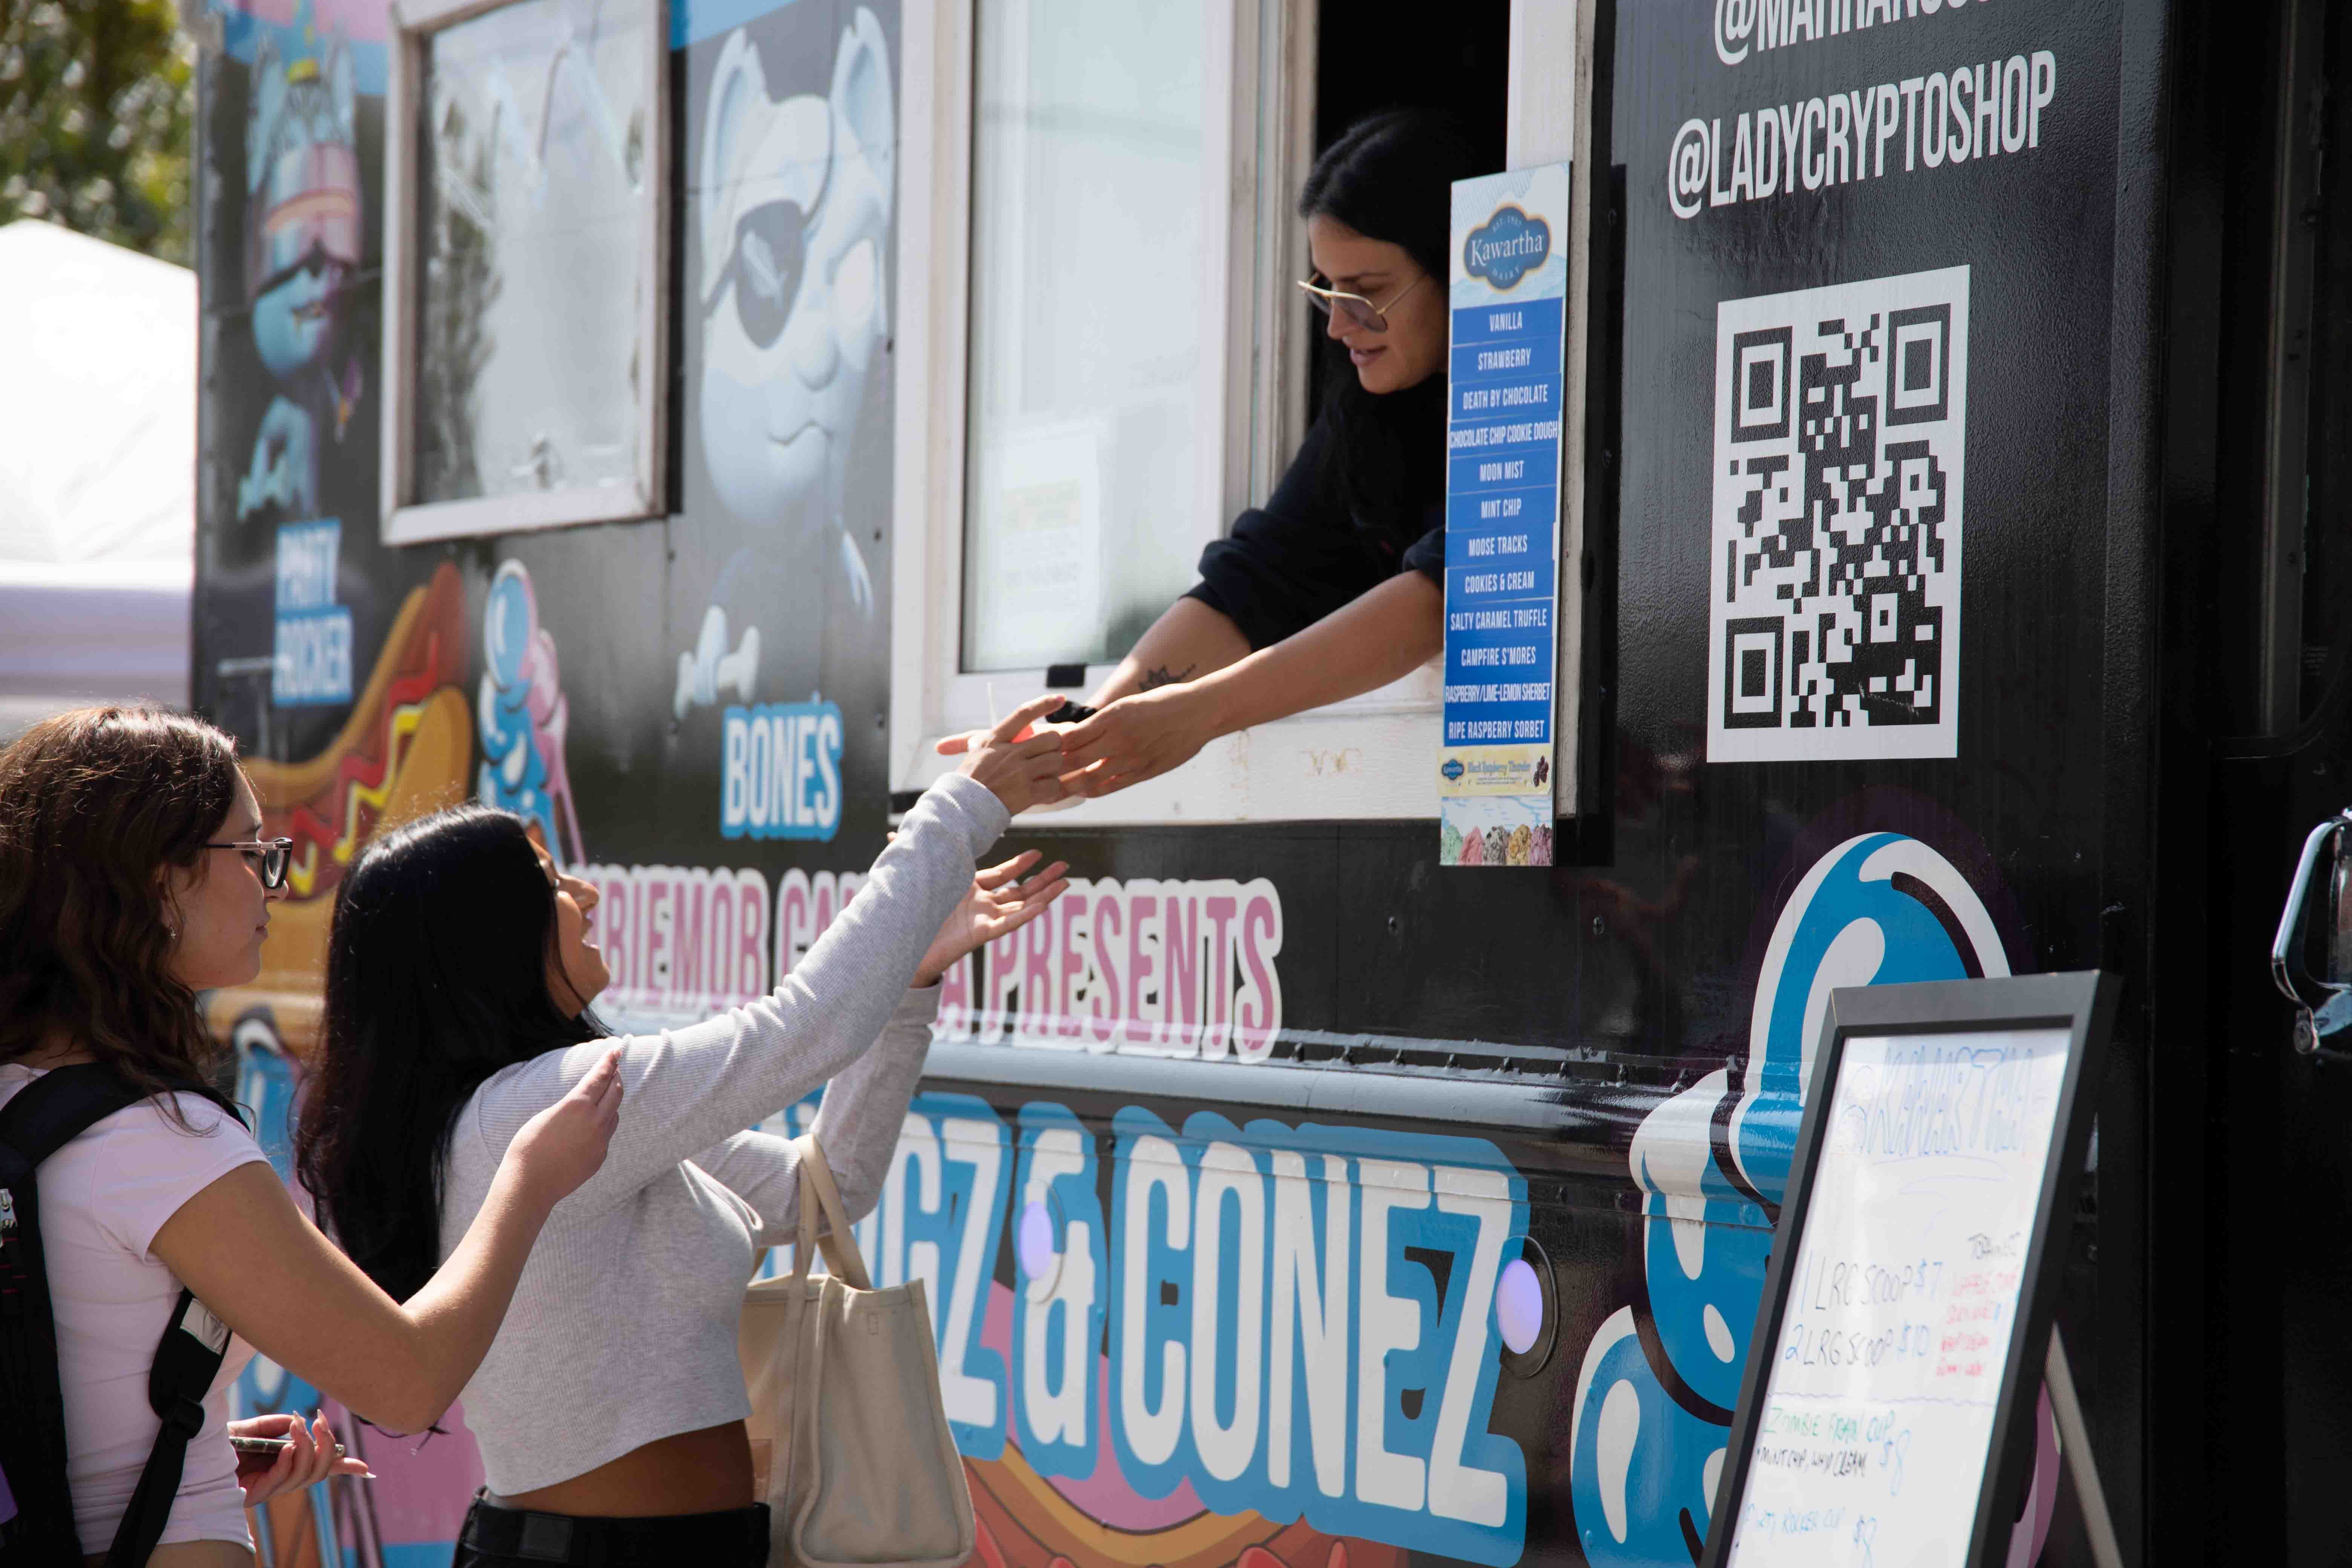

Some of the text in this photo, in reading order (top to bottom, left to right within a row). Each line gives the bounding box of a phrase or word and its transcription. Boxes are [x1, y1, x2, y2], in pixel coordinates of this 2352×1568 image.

[1668, 49, 2056, 219] @LADYCRYPTOSHOP
[1472, 229, 1544, 268] Kawartha
[1490, 312, 1522, 332] VANILLA
[1478, 348, 1531, 371] STRAWBERRY
[1463, 384, 1548, 410] DEATH BY CHOCOLATE
[1450, 420, 1560, 448] CHOCOLATE CHIP COOKIE DOUGH
[1480, 460, 1524, 482] MOON MIST
[1481, 498, 1521, 519] MINT CHIP
[1469, 534, 1528, 557] MOOSE TRACKS
[1465, 571, 1534, 594] COOKIES & CREAM
[1450, 608, 1547, 631] SALTY CARAMEL TRUFFLE
[1461, 646, 1536, 667] CAMPFIRE S'MORES
[1522, 683, 1551, 701] SHERBET
[1449, 720, 1545, 739] RIPE RASPBERRY SORBET
[724, 714, 841, 828] BONES
[988, 895, 1275, 1050] PRESENTS
[1801, 1250, 1813, 1314] 1
[1815, 1256, 1858, 1310] LRG
[1861, 1263, 1913, 1305] SCOOP
[1914, 1258, 1943, 1303] $7
[1119, 1134, 1510, 1528] CONEZ
[1785, 1324, 1803, 1360] 2
[1804, 1328, 1841, 1366] LRG
[1847, 1328, 1893, 1366] SCOOP
[1897, 1323, 1930, 1357] $10
[1762, 1407, 1821, 1436] ZOMBIE
[1866, 1410, 1895, 1443] CUP
[1879, 1429, 1912, 1497] $8
